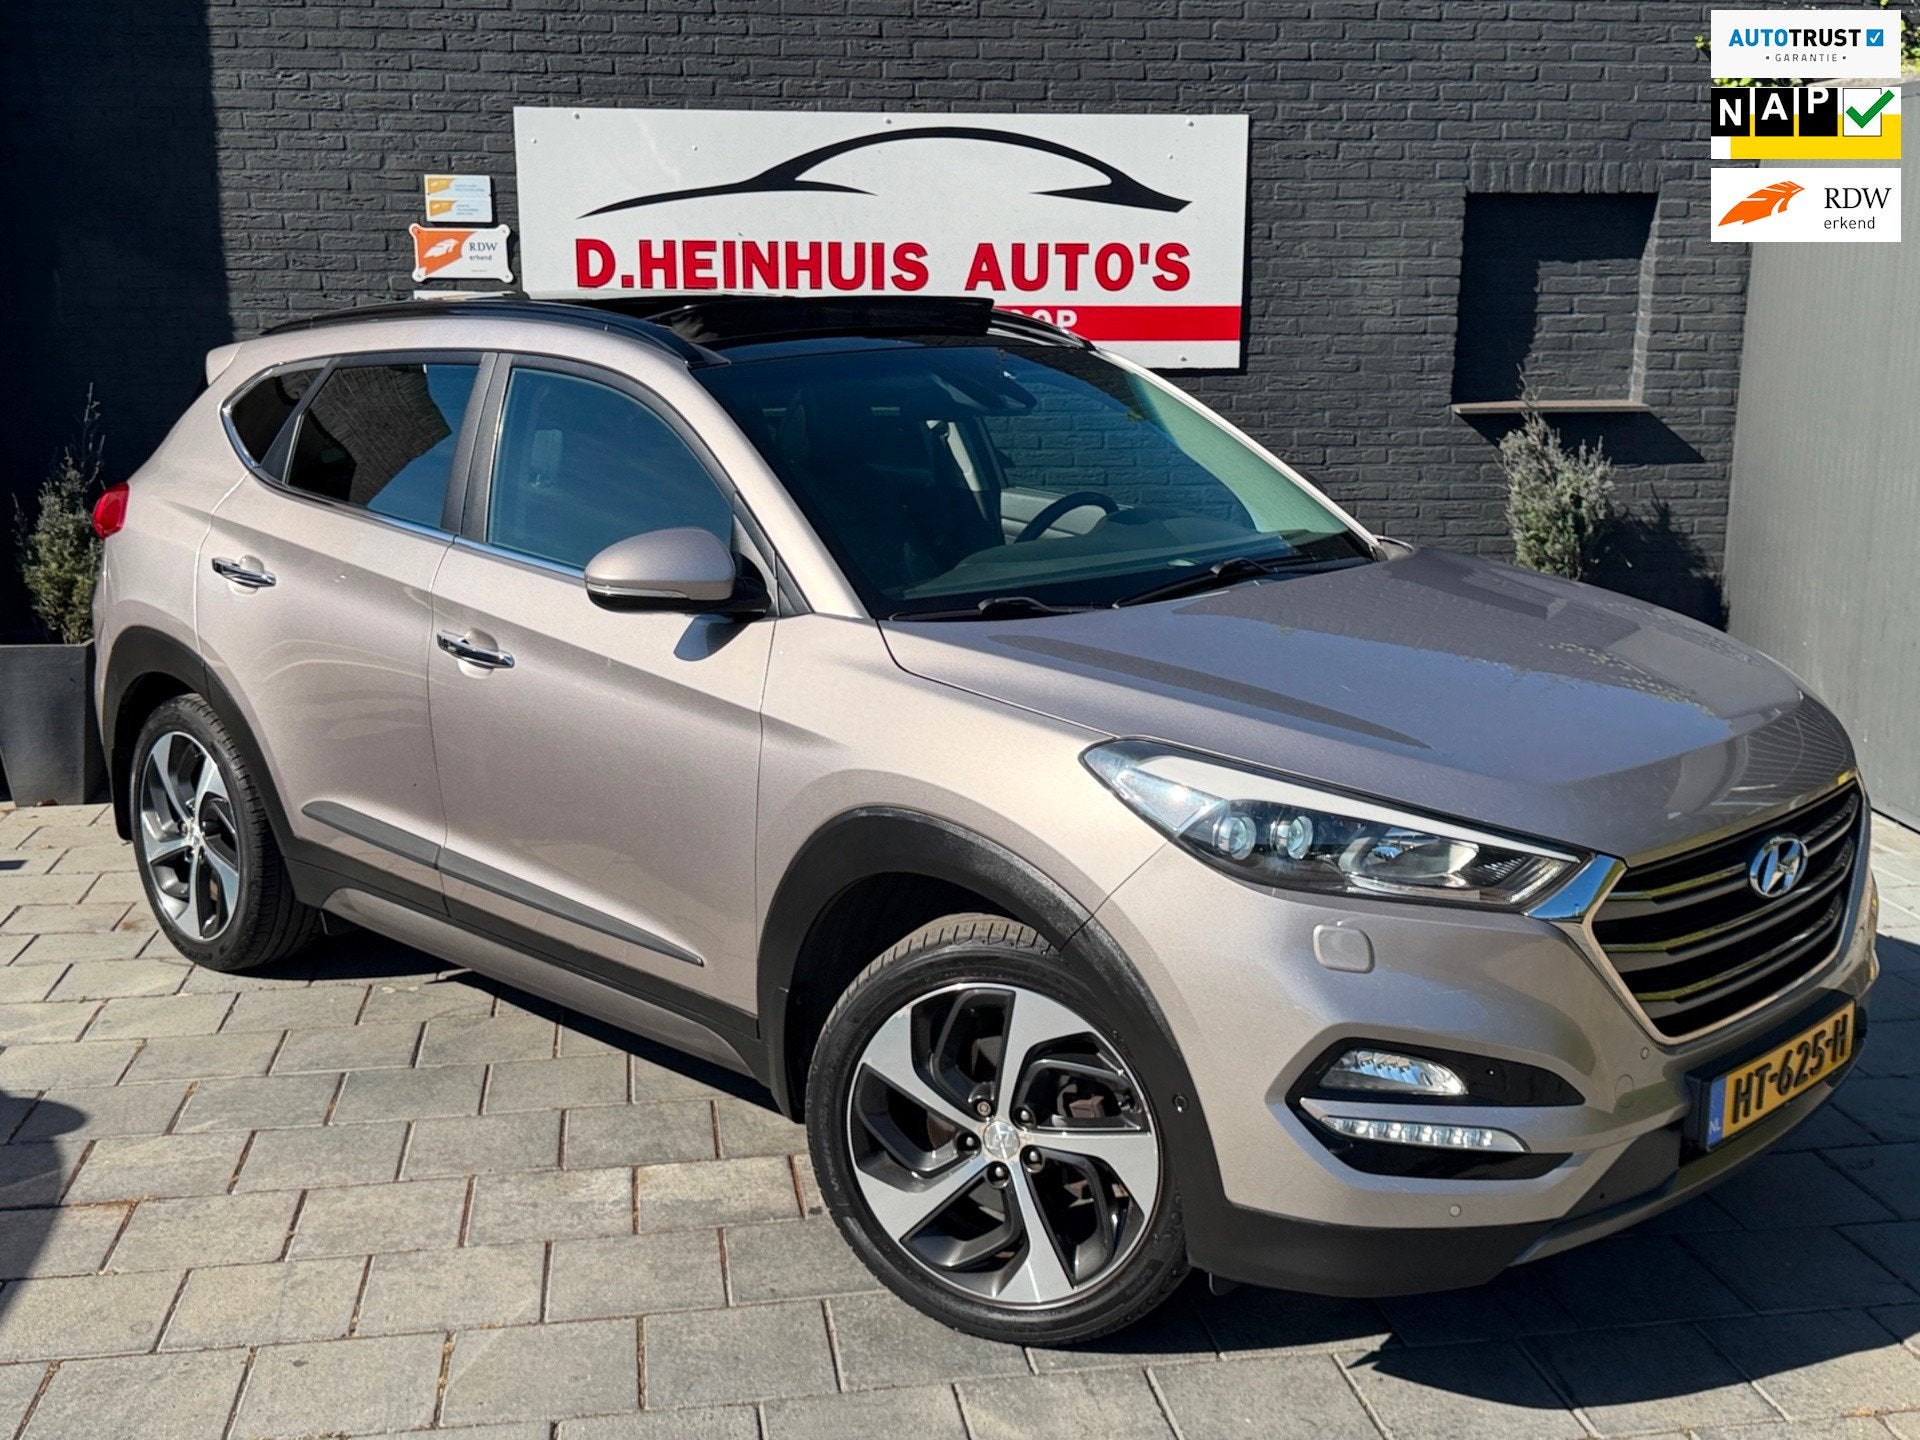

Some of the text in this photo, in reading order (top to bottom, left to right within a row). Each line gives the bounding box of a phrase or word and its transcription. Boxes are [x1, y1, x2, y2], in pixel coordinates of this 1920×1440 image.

[469, 242, 498, 251] RDW
[575, 238, 1191, 292] D.HEINHUIS AUTO'S
[1732, 1014, 1848, 1124] HT-625-H
[1709, 1117, 1722, 1134] NL
